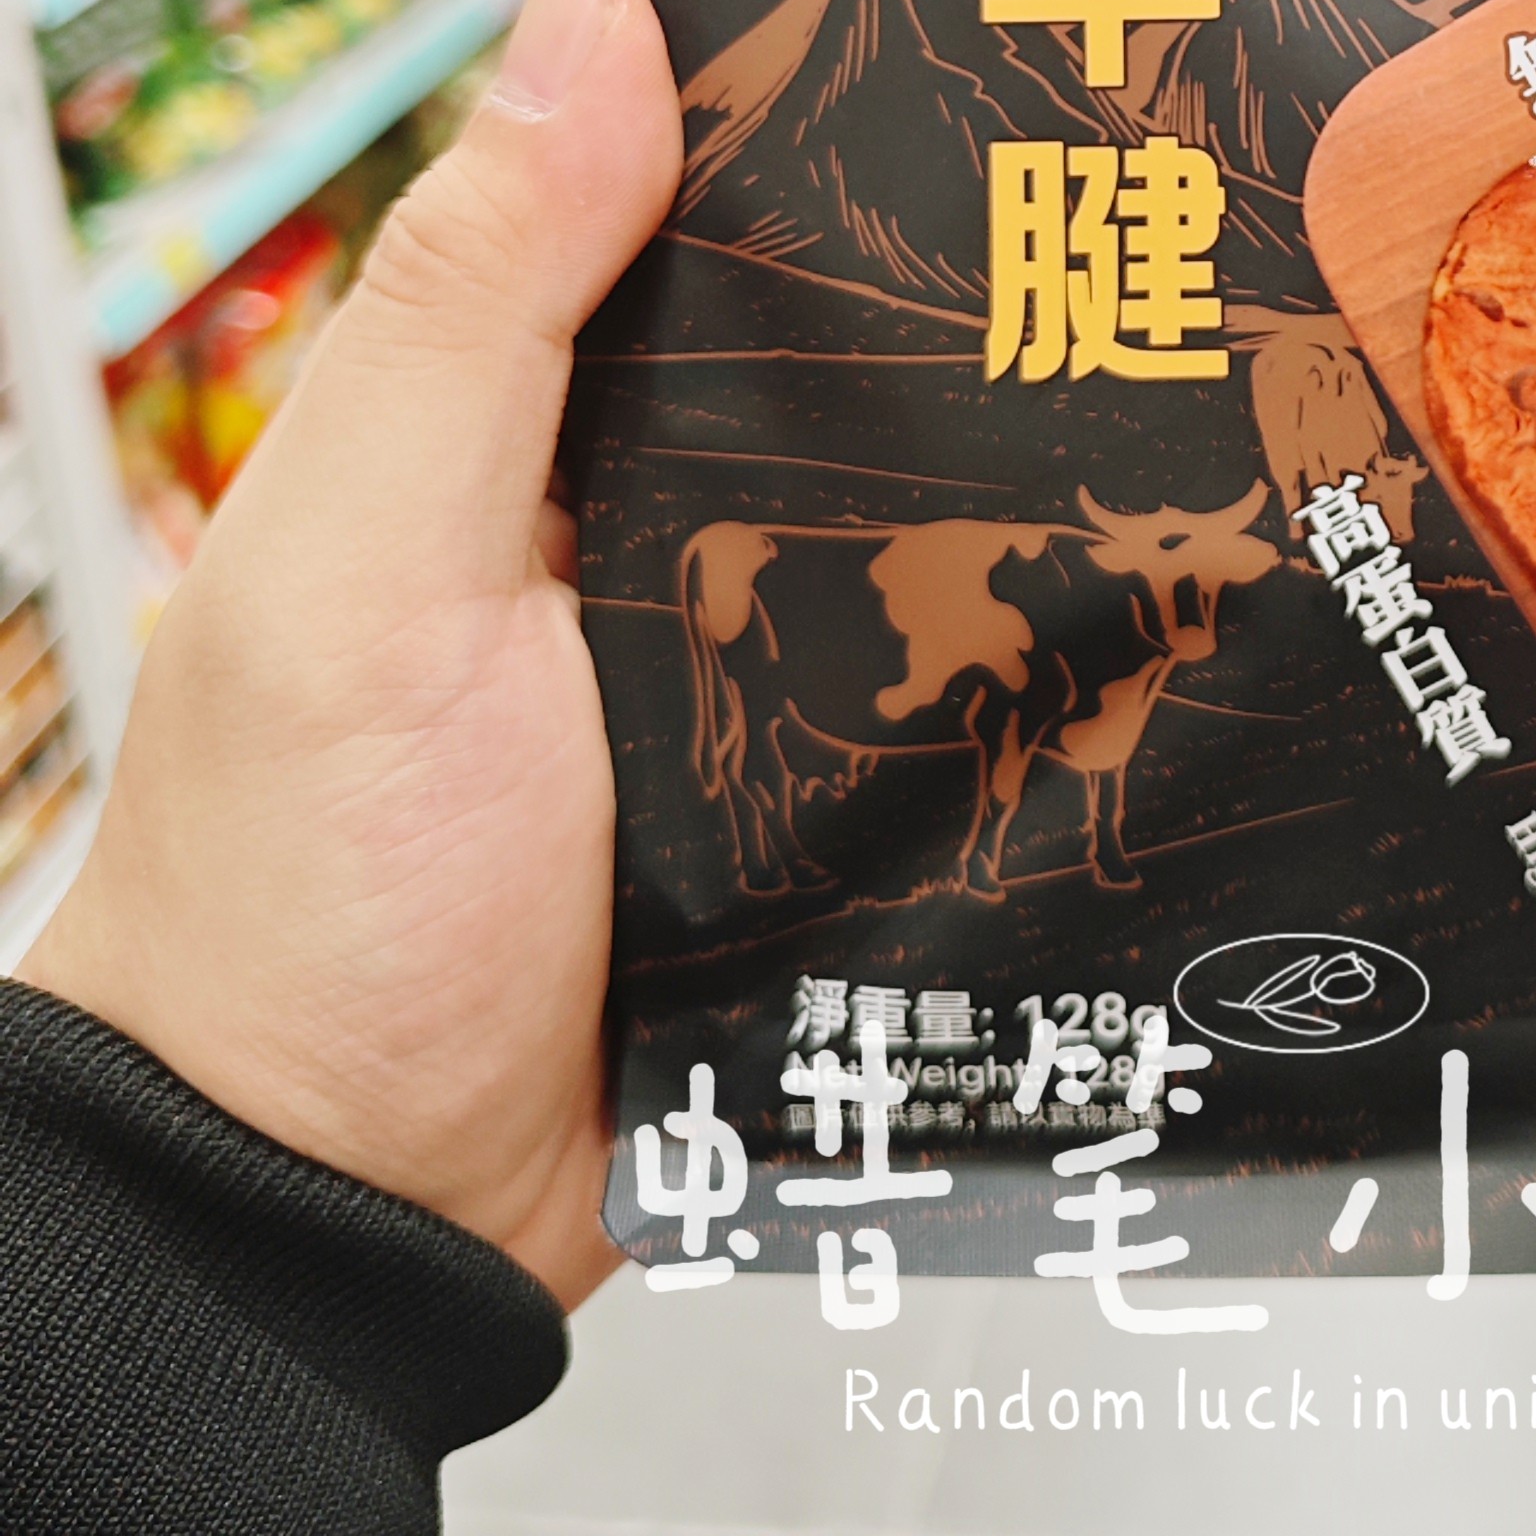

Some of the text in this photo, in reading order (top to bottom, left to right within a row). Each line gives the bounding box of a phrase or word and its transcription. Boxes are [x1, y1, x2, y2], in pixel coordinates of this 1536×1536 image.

[1292, 473, 1512, 788] 高蛋白質
[1014, 990, 1168, 1060] 128g
